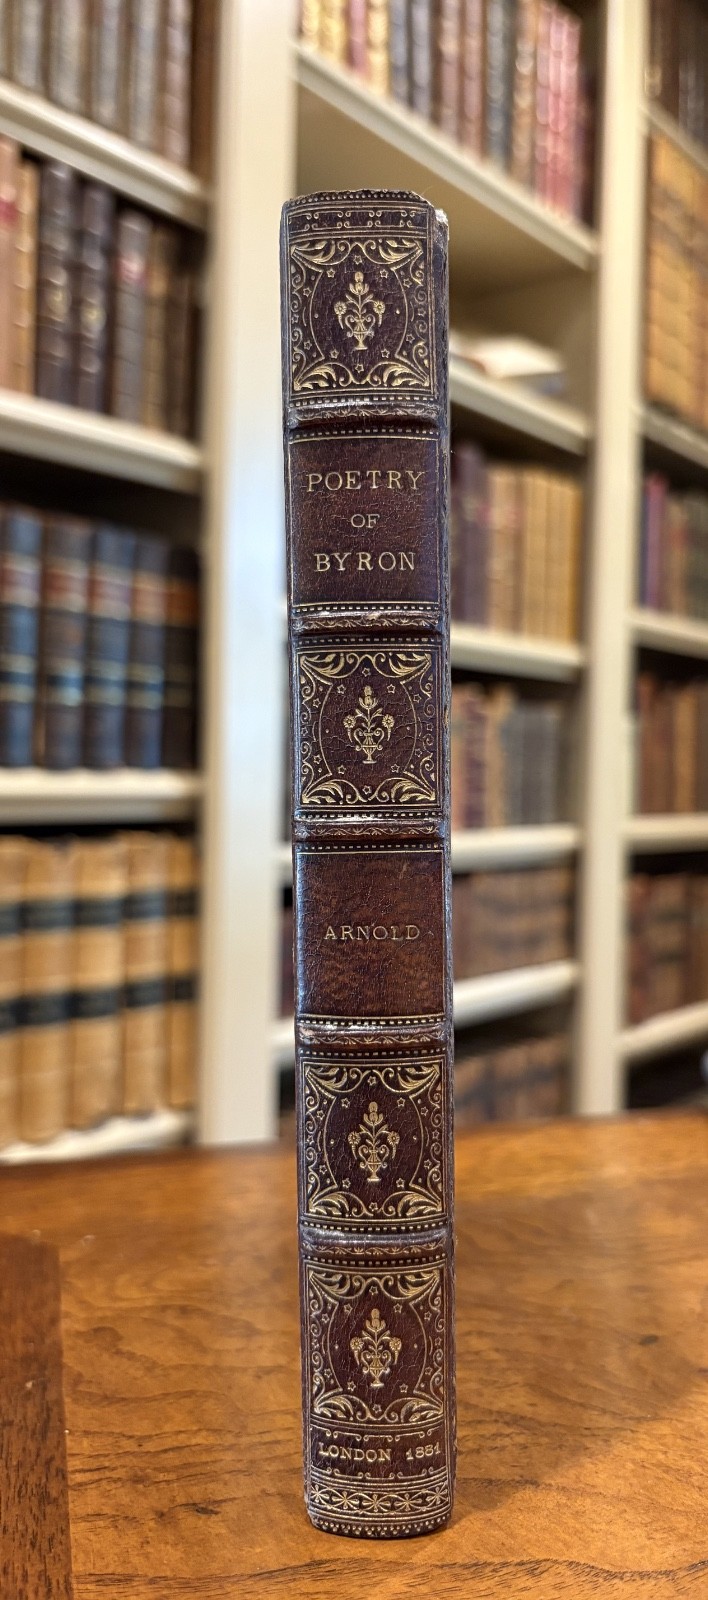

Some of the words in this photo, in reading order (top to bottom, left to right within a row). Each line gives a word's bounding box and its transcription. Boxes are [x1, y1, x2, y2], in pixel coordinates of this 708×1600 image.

[306, 470, 426, 492] POETRY
[350, 513, 380, 529] OF
[314, 551, 416, 572] BYRON
[324, 924, 421, 941] ARNOLD
[318, 1441, 392, 1462] LONDON
[405, 1441, 441, 1461] 1881
